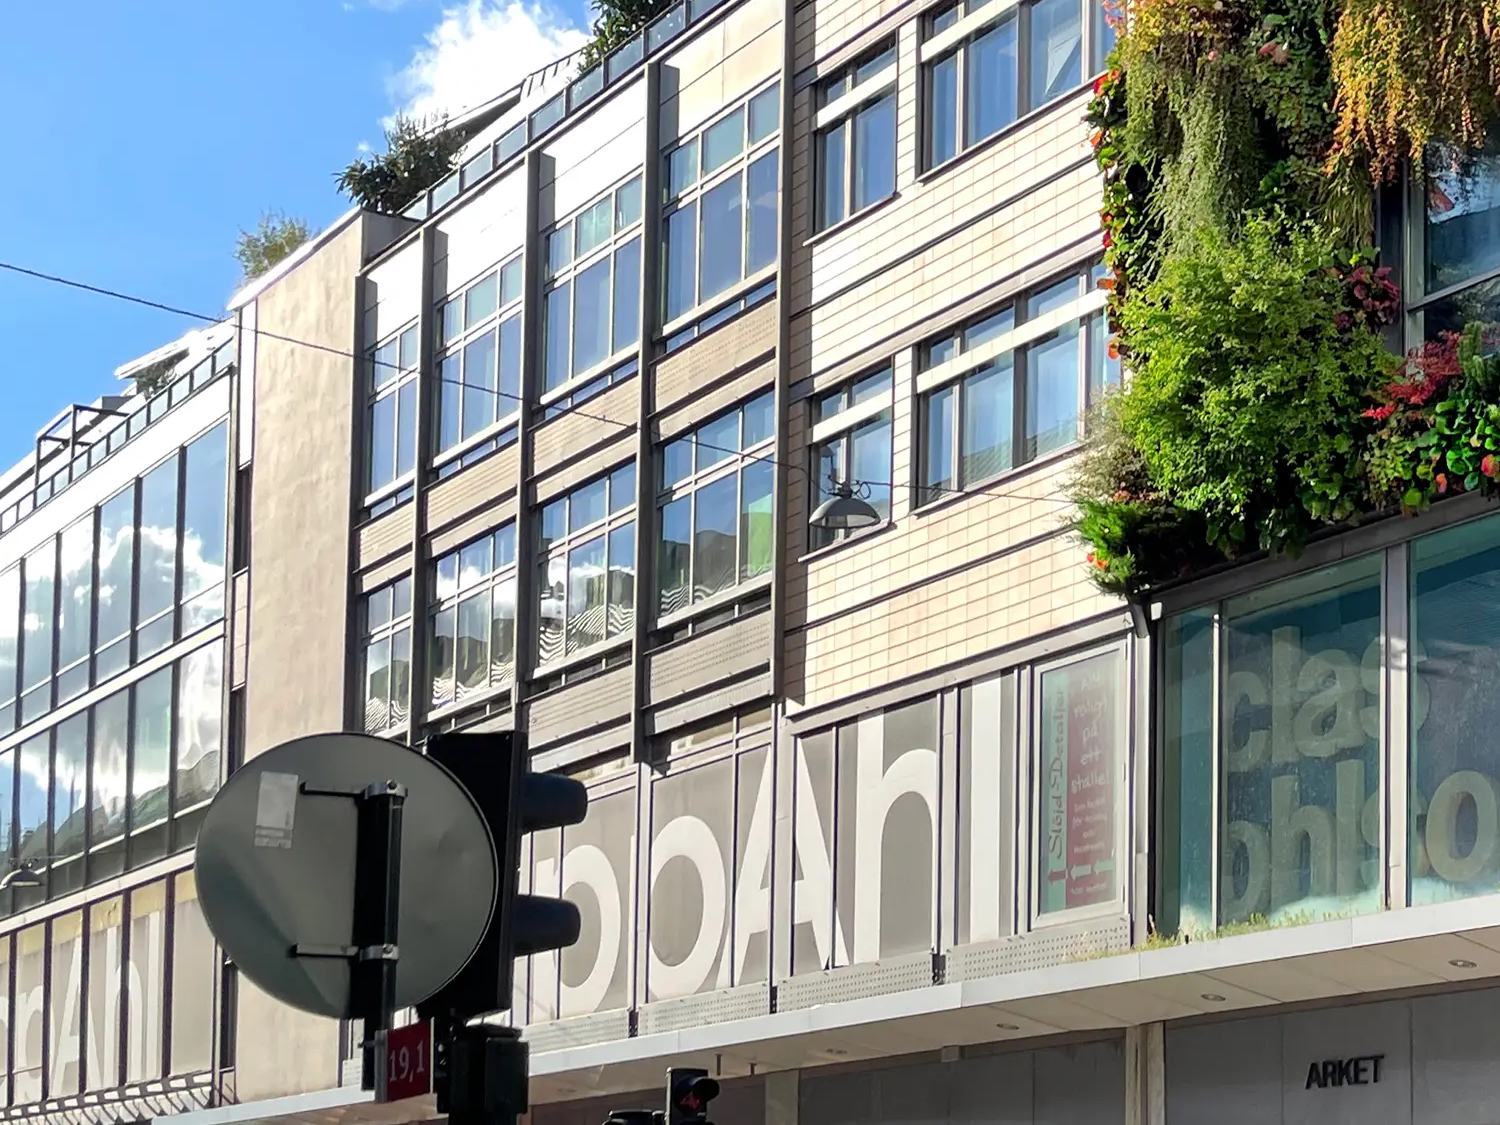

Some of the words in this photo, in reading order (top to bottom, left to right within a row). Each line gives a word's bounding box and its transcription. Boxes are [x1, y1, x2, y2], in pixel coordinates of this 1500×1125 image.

[0, 910, 163, 1107] pAhl
[389, 1038, 425, 1083] 19,1
[1305, 1054, 1385, 1090] ARKET
